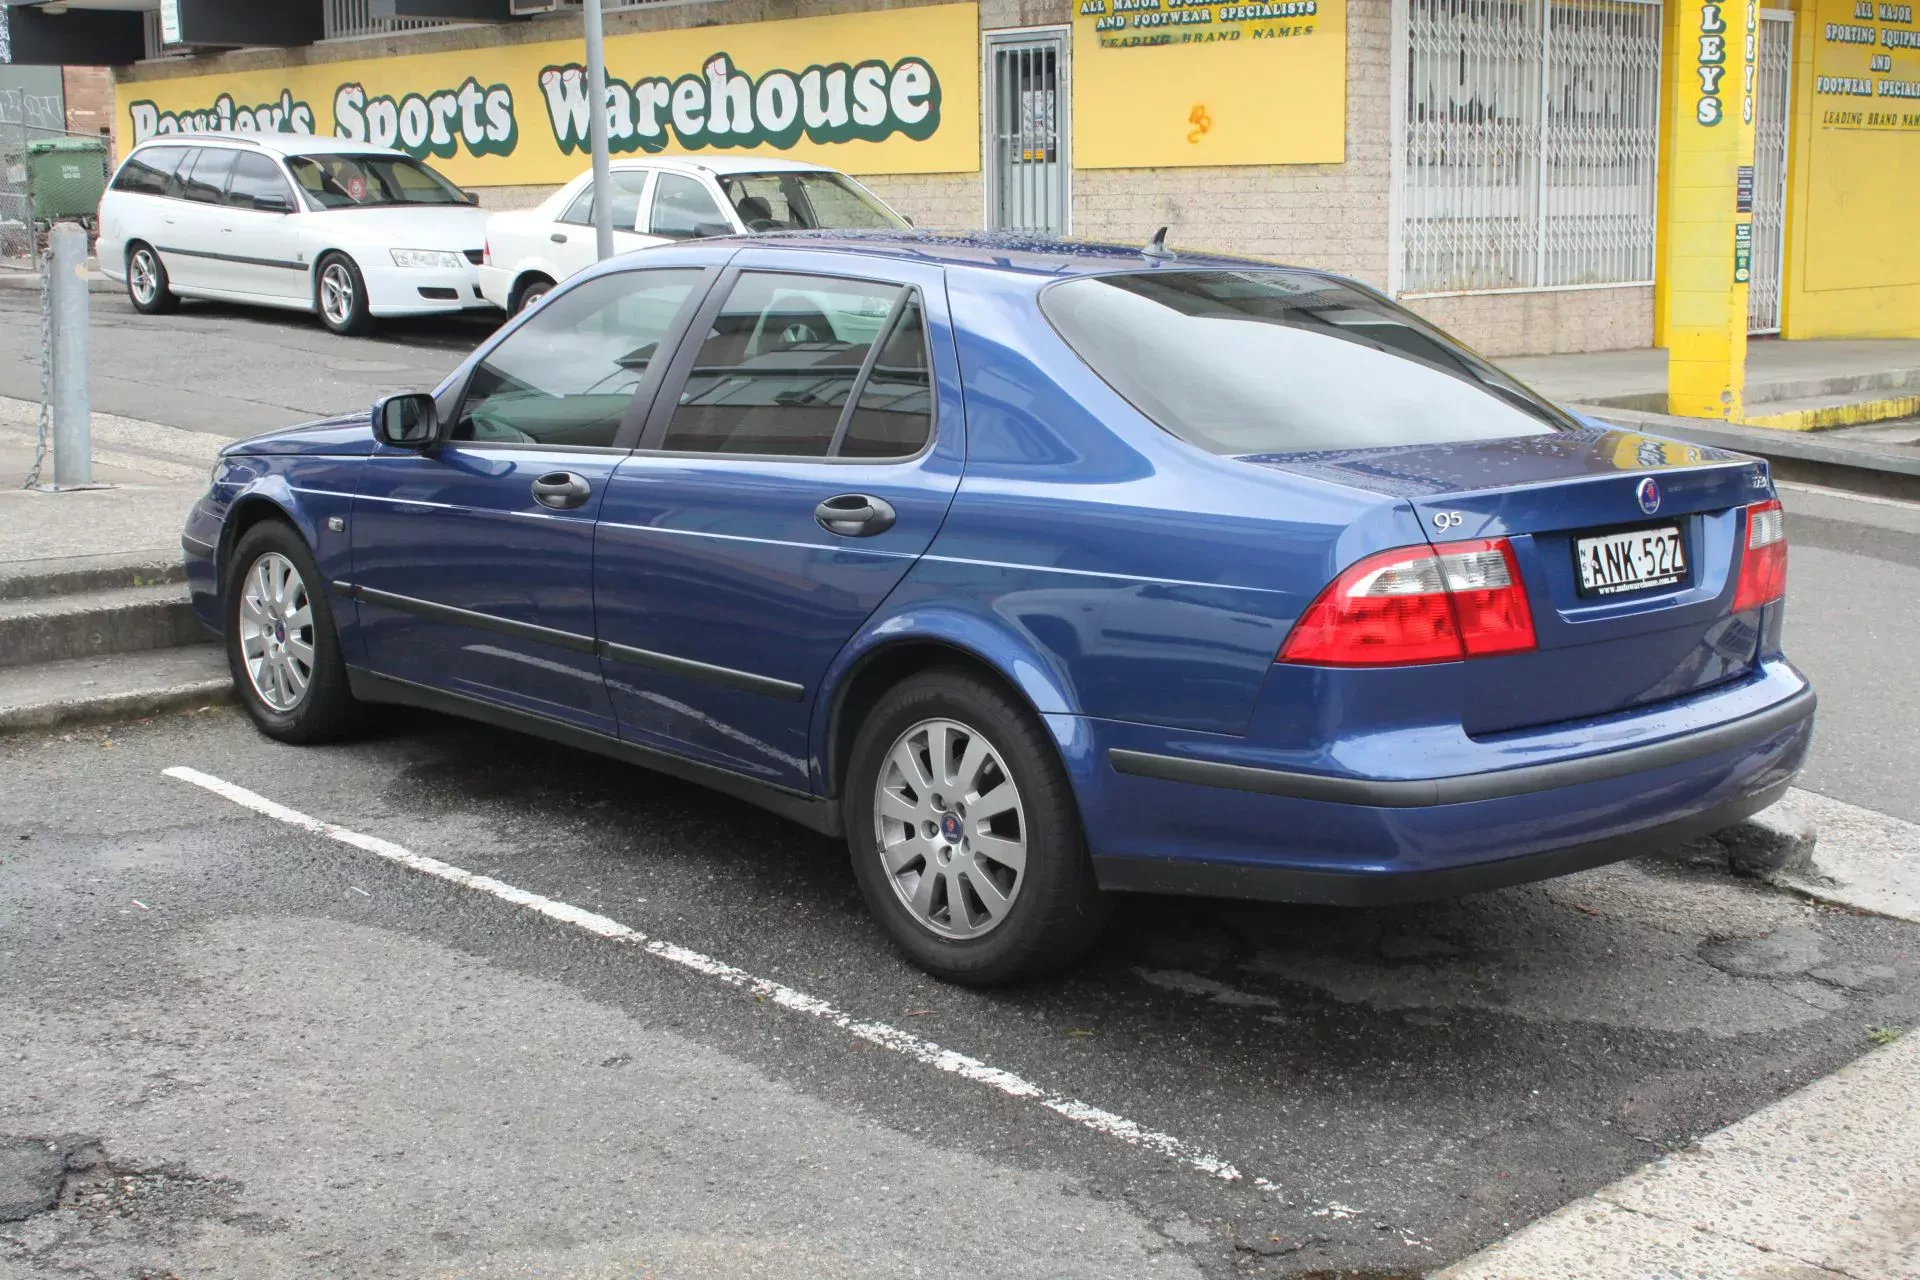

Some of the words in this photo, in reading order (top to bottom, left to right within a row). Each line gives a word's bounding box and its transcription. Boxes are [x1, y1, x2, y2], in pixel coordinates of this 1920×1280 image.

[1080, 0, 1106, 14] ALL
[1113, 0, 1160, 11] MAJOR
[1097, 15, 1126, 30] AND
[1133, 9, 1212, 28] FOOTWEAR
[1219, 2, 1316, 20] SPECIALISTS
[1854, 2, 1873, 18] ALL
[1879, 4, 1911, 21] MAJOR
[1182, 30, 1241, 43] BRAND
[1252, 26, 1314, 39] NAMES
[1825, 24, 1875, 43] SPORTING
[1698, 5, 1721, 123] LEYS
[1870, 55, 1891, 71] AND
[1817, 76, 1872, 95] FOOTWEAR
[335, 80, 513, 148] Sports
[541, 56, 932, 141] Warehouse
[1823, 111, 1863, 126] LEADING
[1867, 112, 1898, 126] BRAND
[1434, 511, 1463, 534] 95
